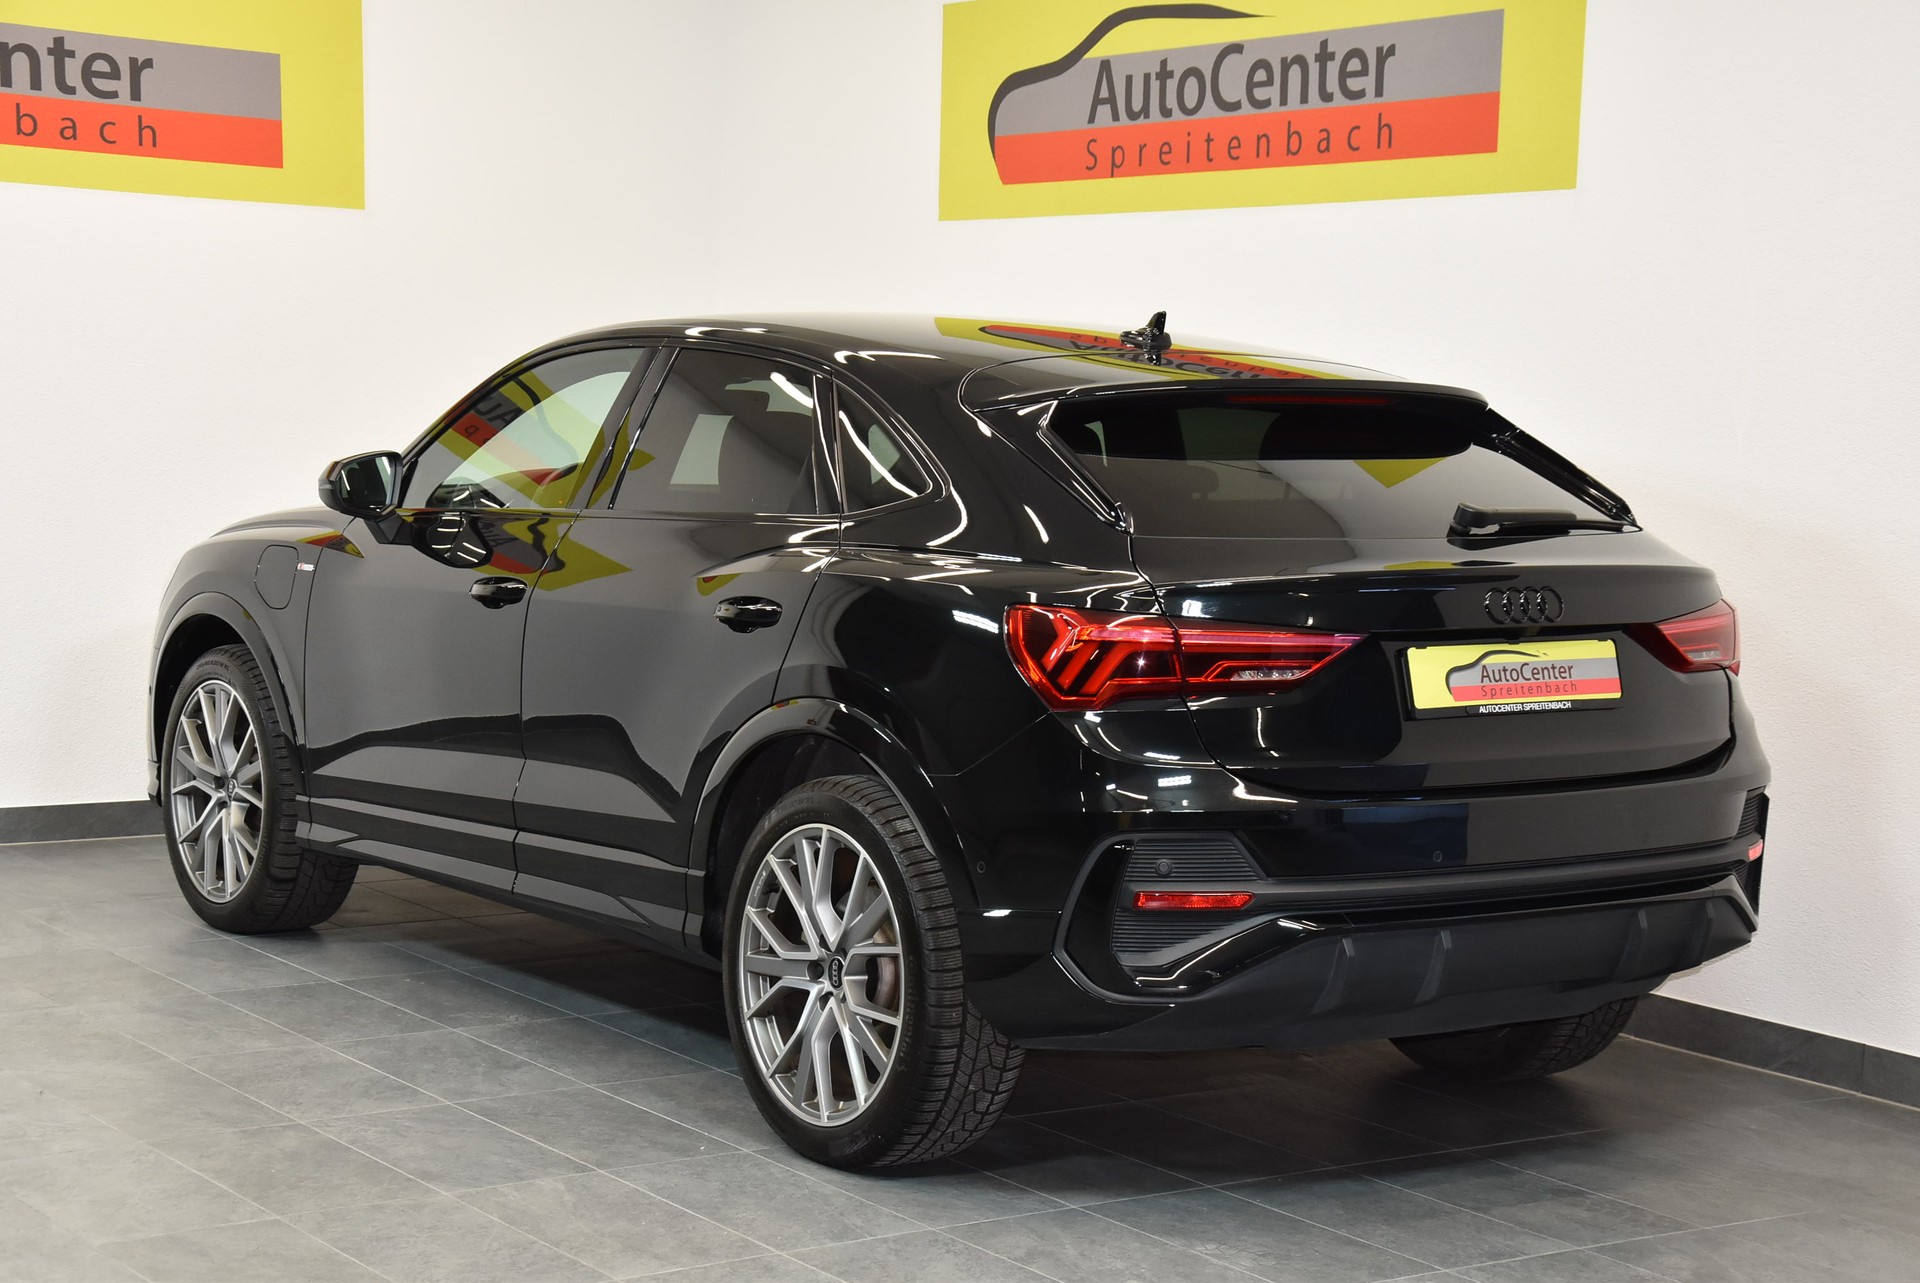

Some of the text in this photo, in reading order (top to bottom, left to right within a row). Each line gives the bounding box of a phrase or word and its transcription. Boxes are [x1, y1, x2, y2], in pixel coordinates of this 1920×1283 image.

[1087, 37, 1396, 125] AutoCenter
[1085, 112, 1393, 178] Spreitenbach
[1480, 662, 1573, 684] AutoCenter
[1480, 681, 1577, 699] Spreitenbach
[1479, 701, 1572, 713] AUTOCENTER SPREITENBACH
